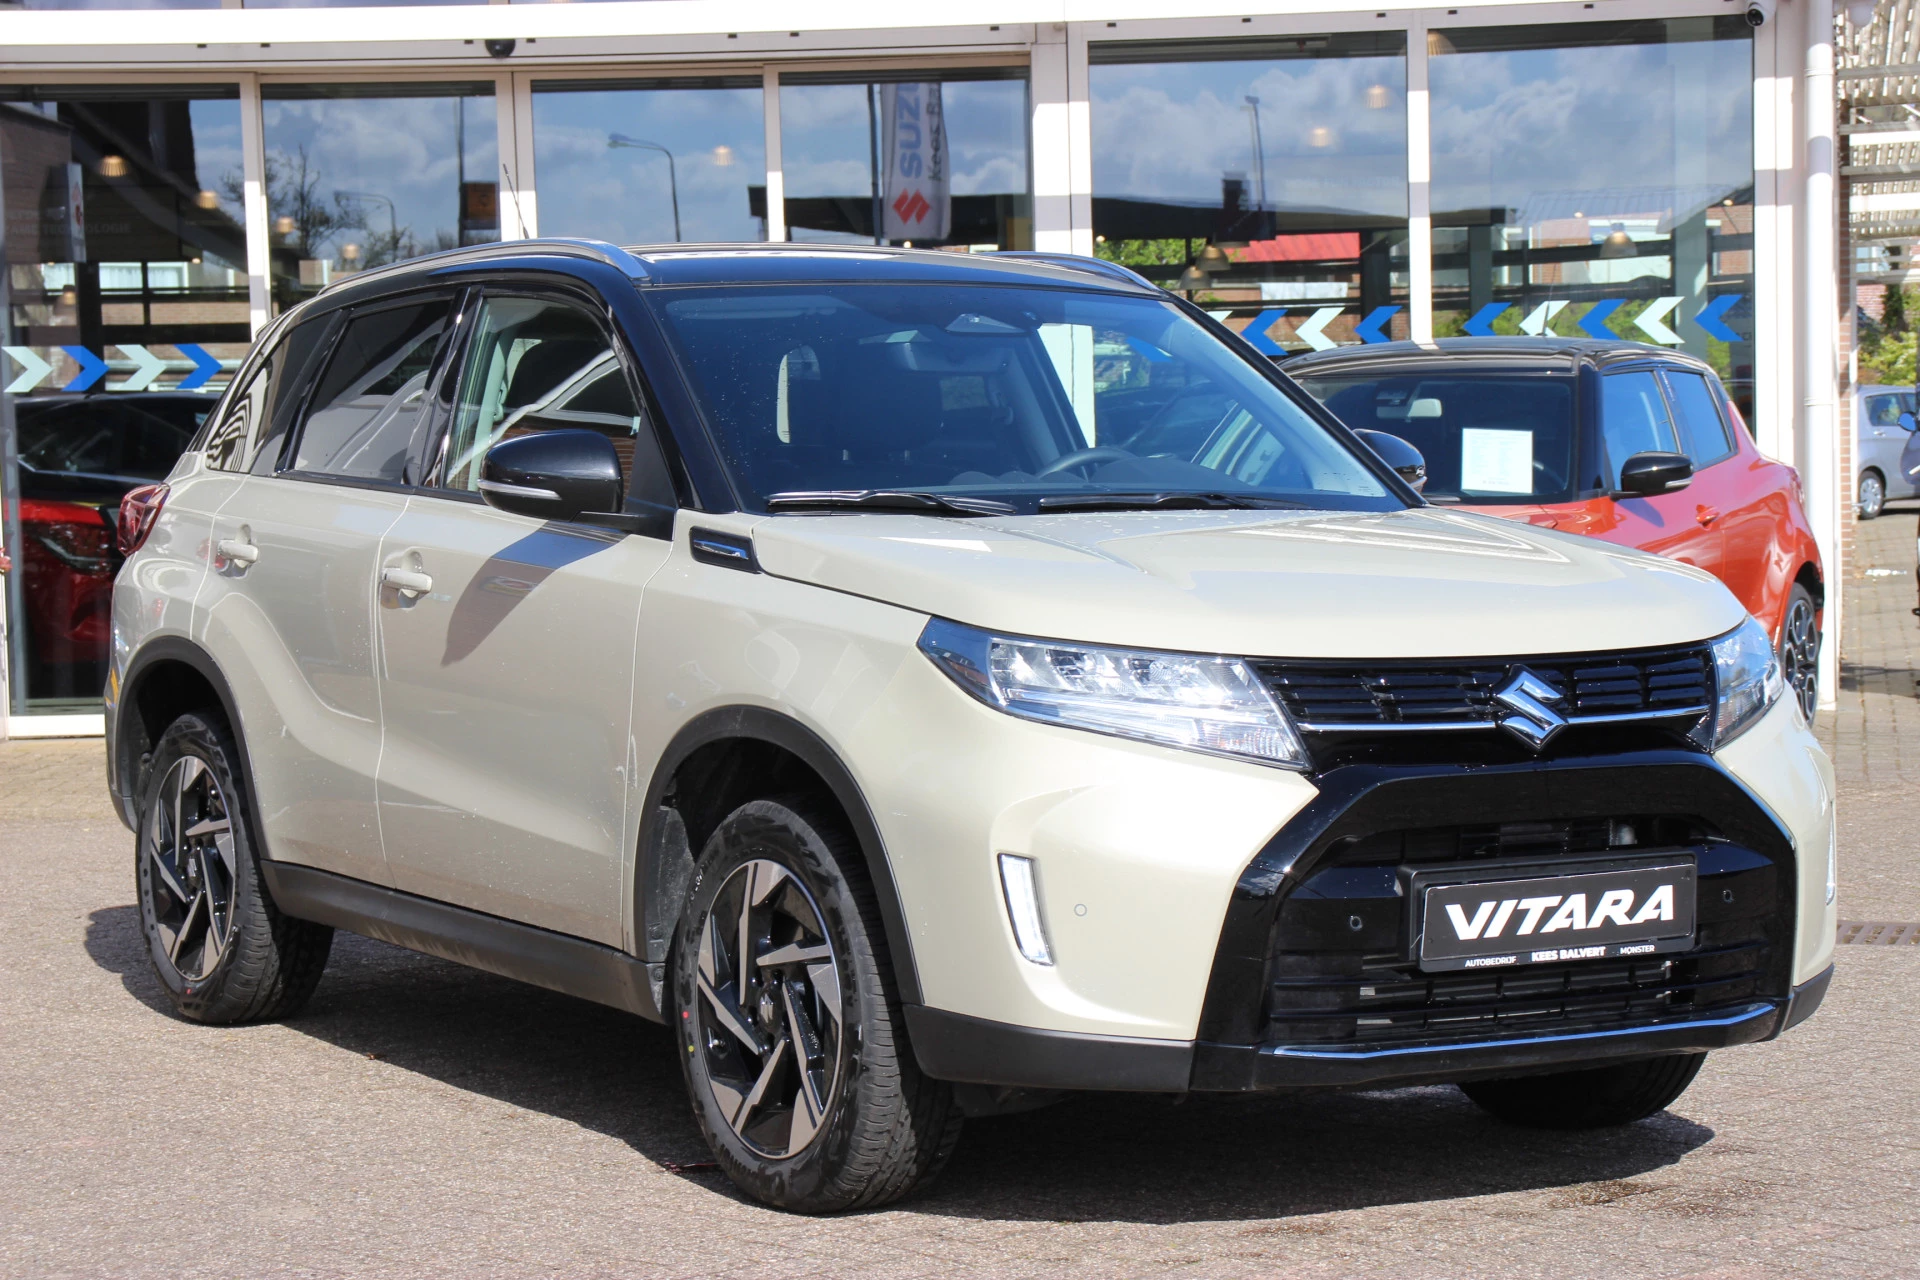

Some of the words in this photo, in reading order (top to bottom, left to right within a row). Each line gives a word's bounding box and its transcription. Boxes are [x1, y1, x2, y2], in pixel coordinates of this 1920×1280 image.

[1445, 885, 1674, 940] VITARA
[1465, 955, 1517, 968] AUTOBEDRIJF
[1531, 950, 1558, 962] KEES
[1559, 946, 1606, 960] BALVERT
[1620, 945, 1655, 955] MONSTER
